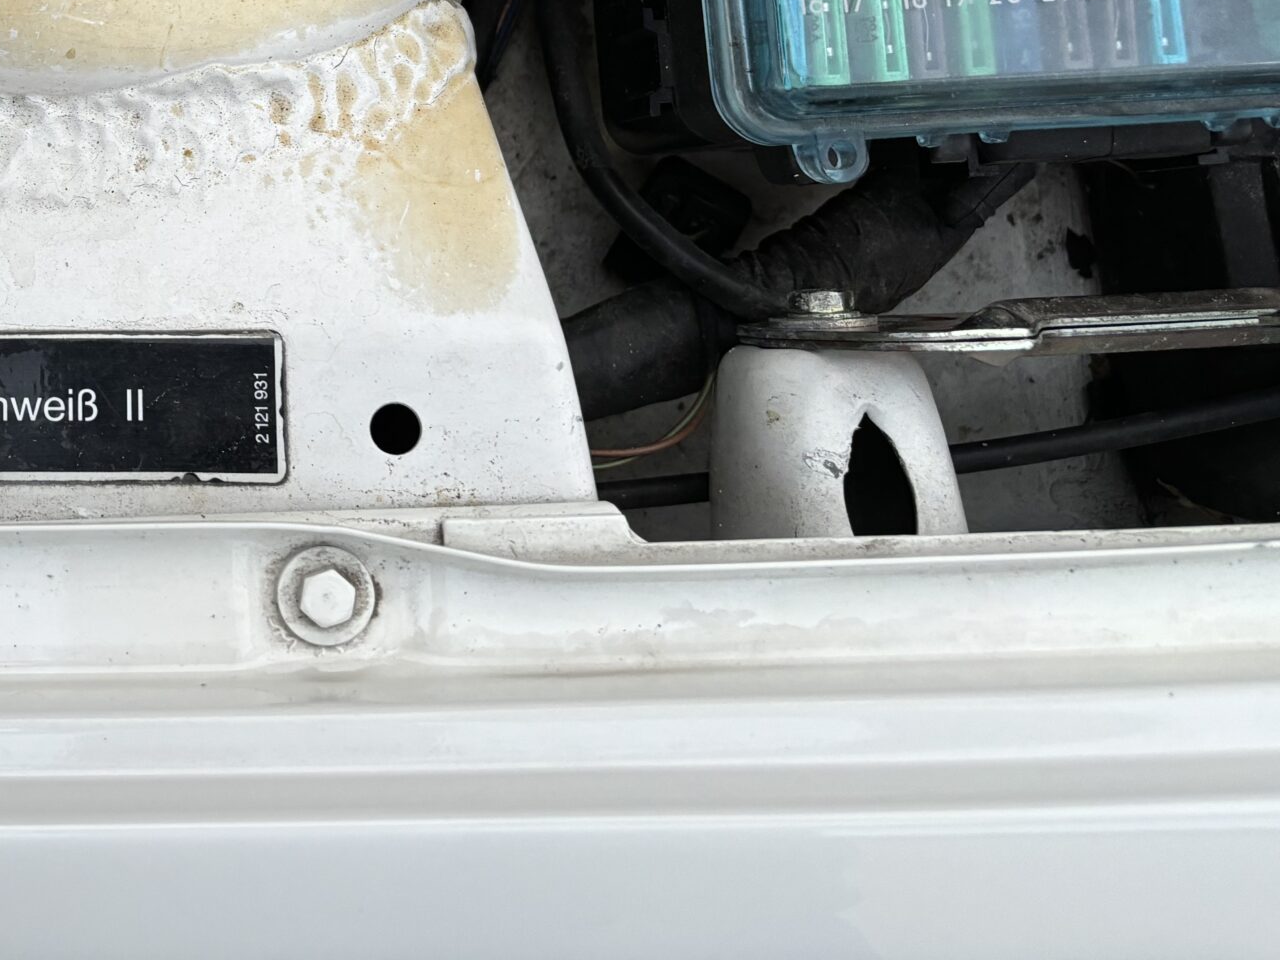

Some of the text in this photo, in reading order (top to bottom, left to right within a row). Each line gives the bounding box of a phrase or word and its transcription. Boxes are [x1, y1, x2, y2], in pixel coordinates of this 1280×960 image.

[253, 372, 270, 444] 2 121 931
